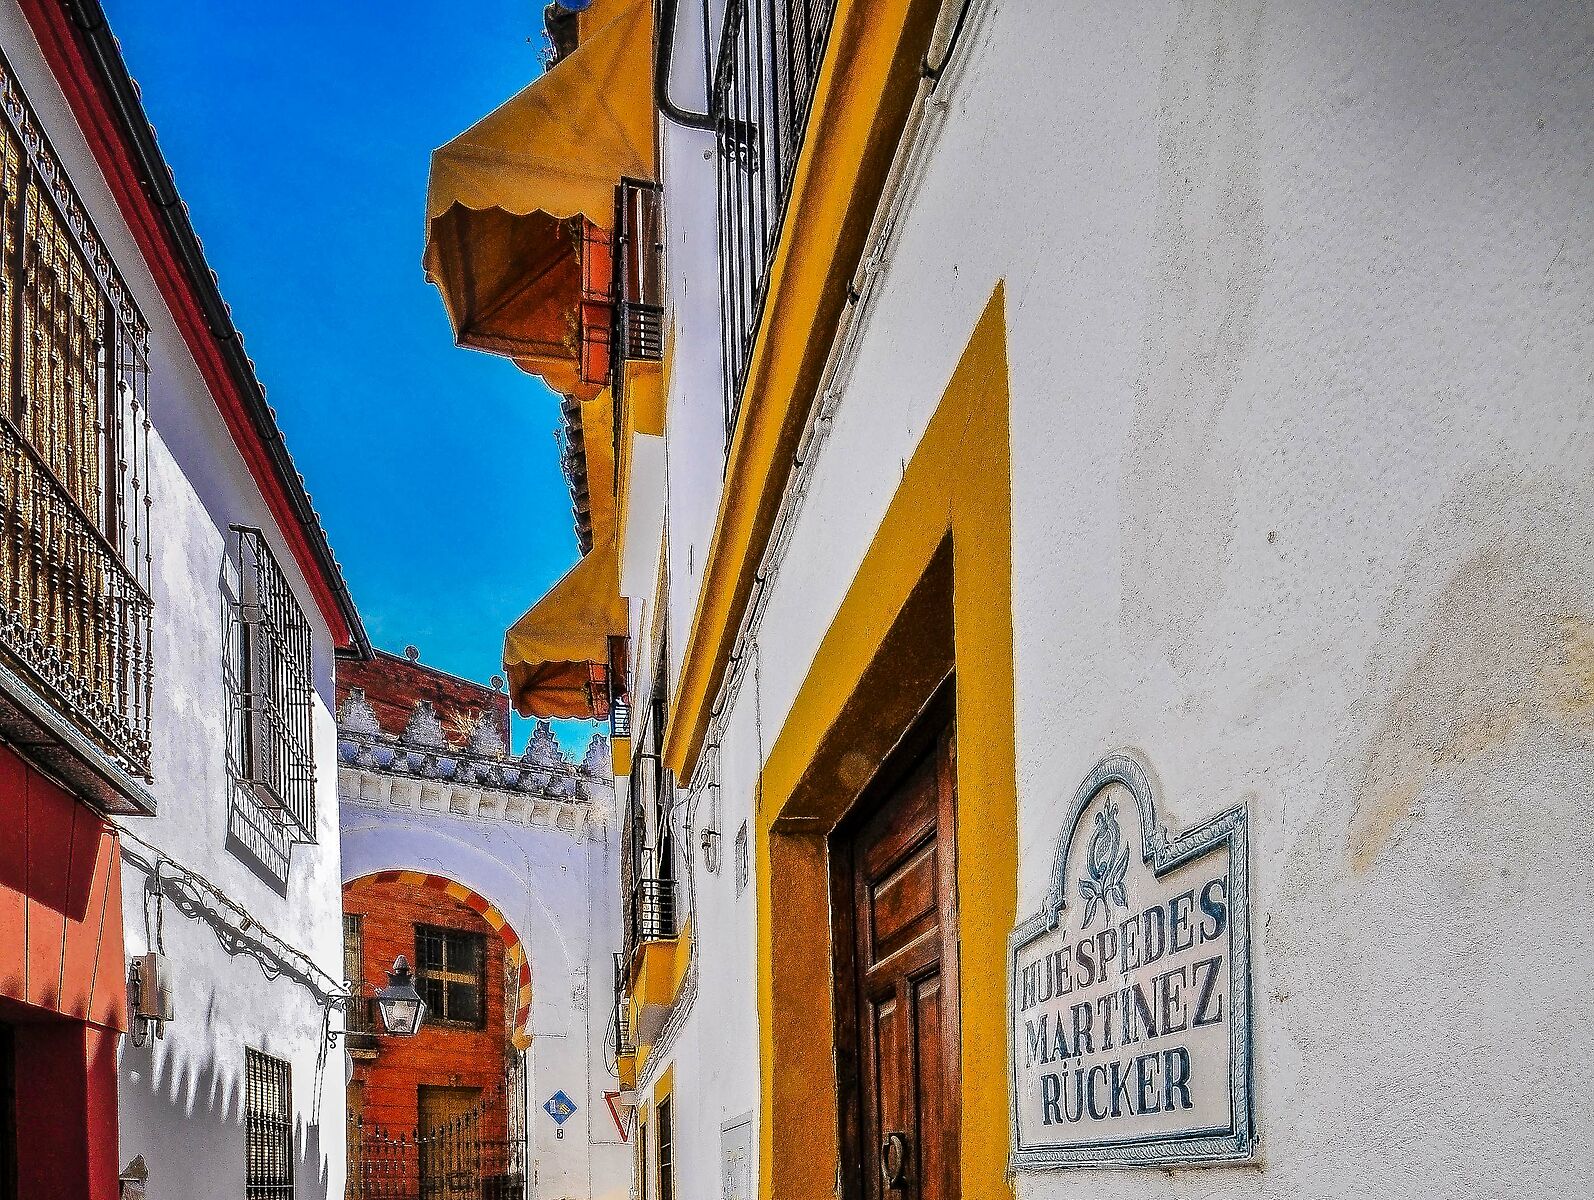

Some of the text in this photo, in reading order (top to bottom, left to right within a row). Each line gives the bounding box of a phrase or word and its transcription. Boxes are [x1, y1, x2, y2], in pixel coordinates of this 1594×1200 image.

[1021, 874, 1228, 1012] HUÉSPEDES
[1025, 954, 1223, 1069] MARTÍNEZ
[1041, 1046, 1193, 1126] RÜCKER
